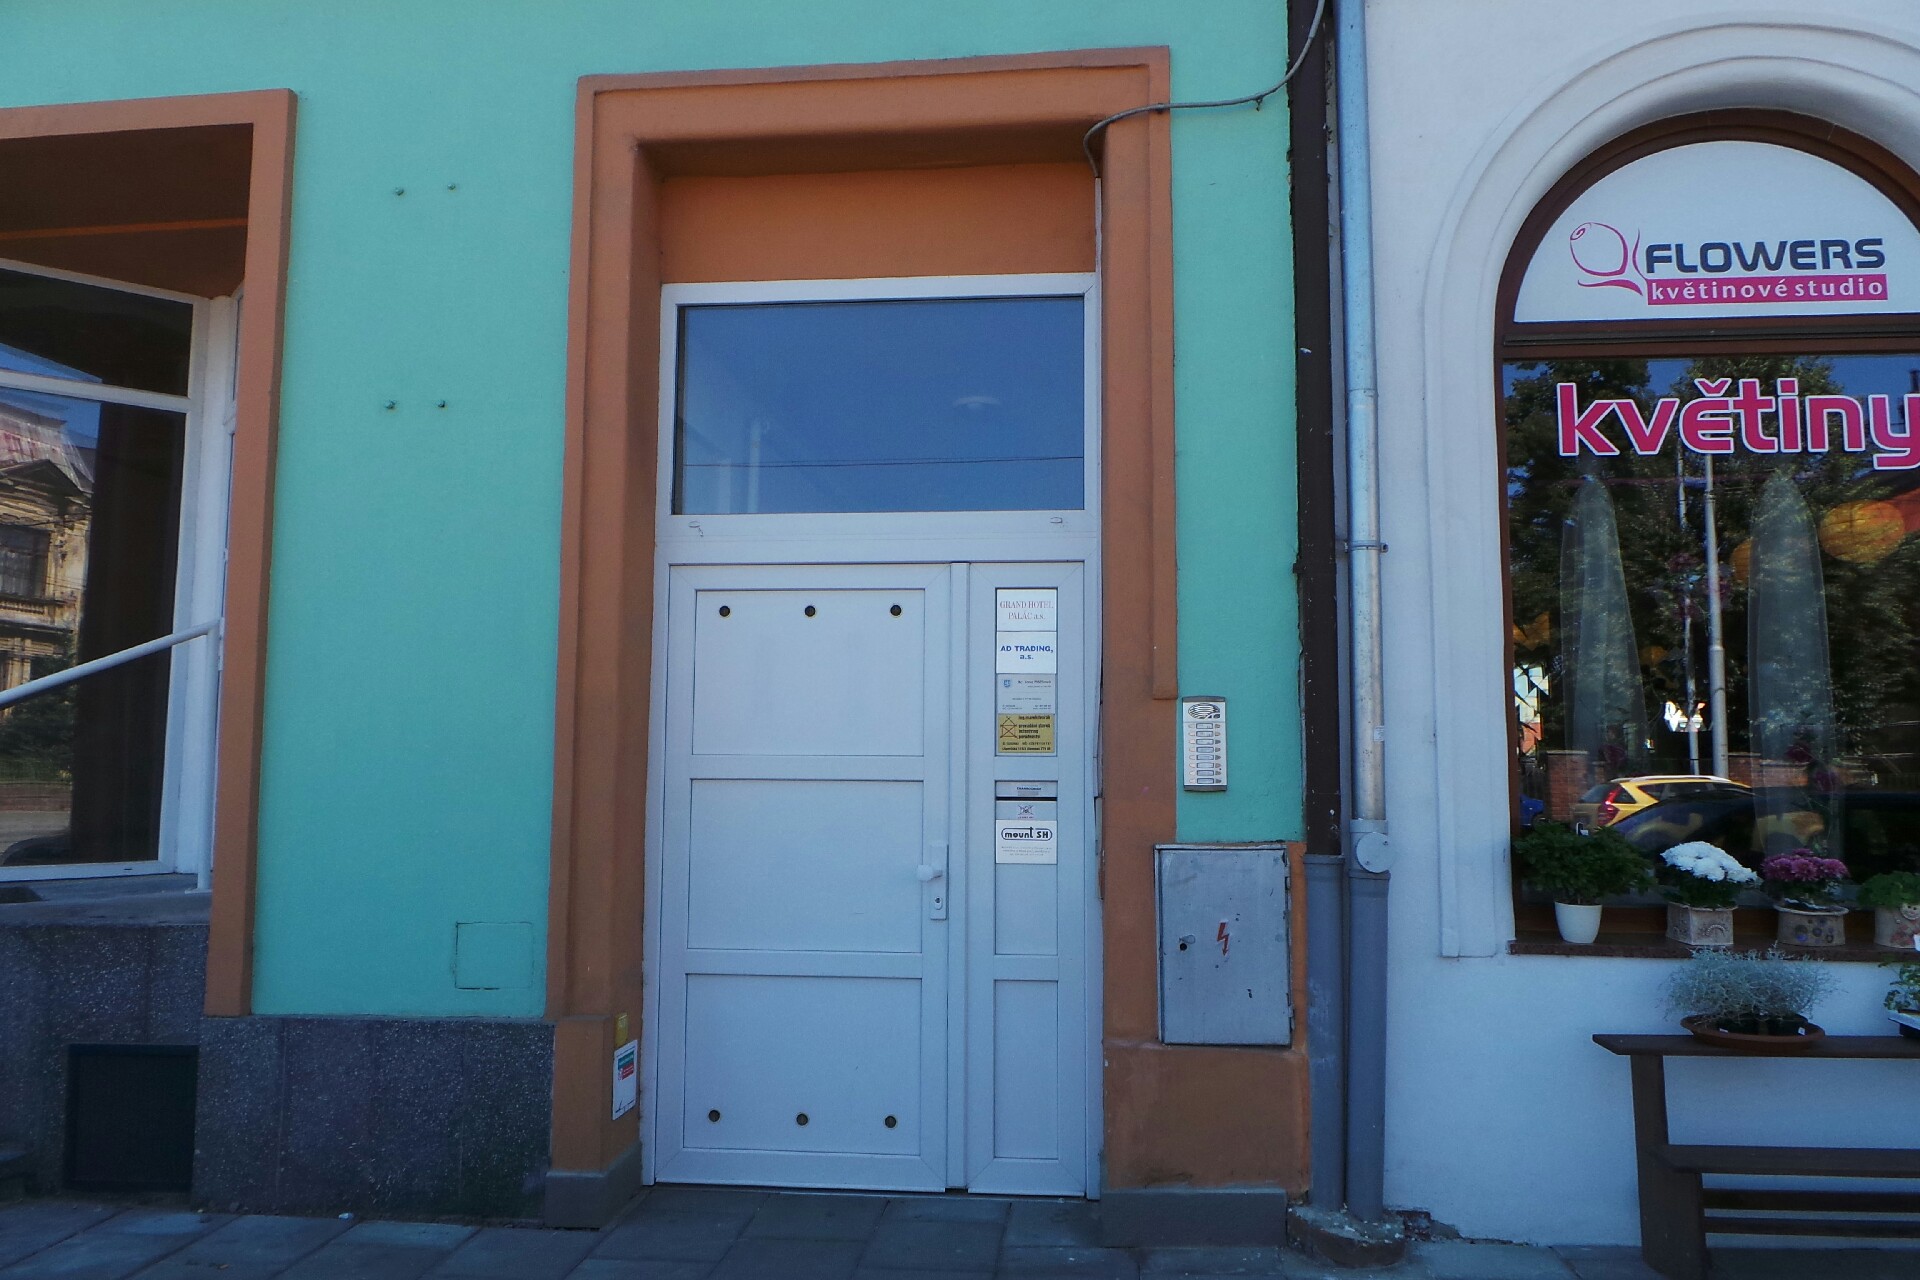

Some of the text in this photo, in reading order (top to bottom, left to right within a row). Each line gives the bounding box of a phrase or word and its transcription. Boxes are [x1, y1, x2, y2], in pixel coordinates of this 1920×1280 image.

[1646, 238, 1886, 274] FLOWERS
[1652, 277, 1883, 300] květinové studio
[1557, 378, 1920, 470] květiny
[1000, 600, 1054, 609] GRAND HOTEL
[1014, 645, 1054, 653] TRADING,
[1004, 827, 1049, 839] mount SH
